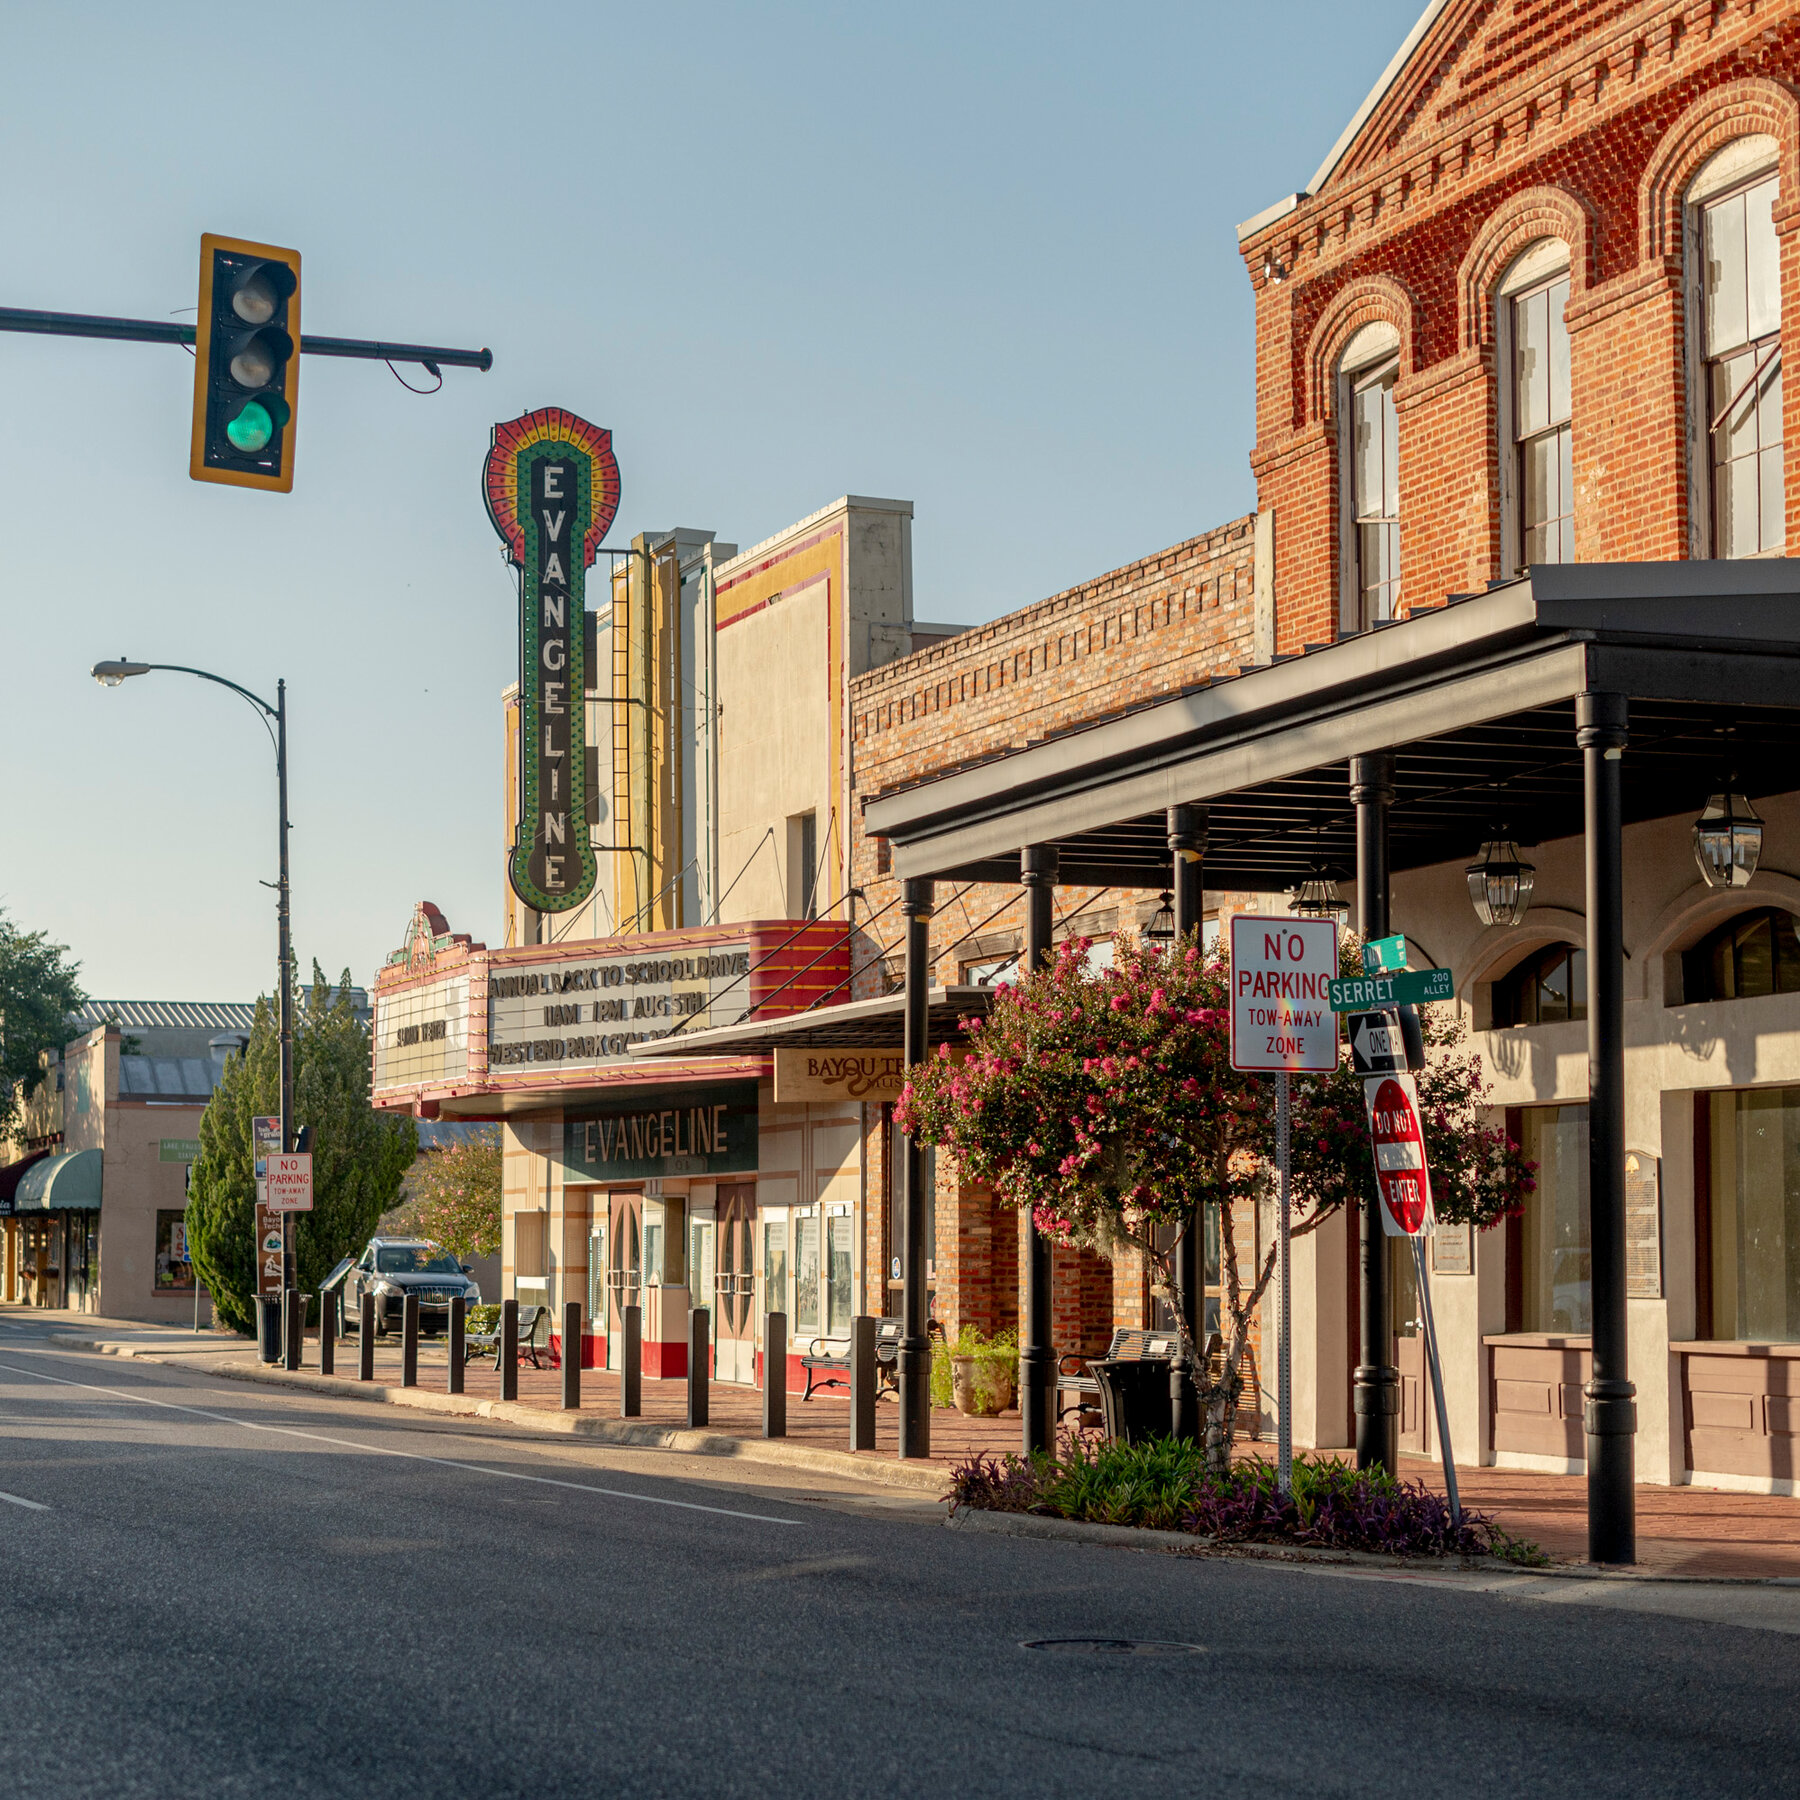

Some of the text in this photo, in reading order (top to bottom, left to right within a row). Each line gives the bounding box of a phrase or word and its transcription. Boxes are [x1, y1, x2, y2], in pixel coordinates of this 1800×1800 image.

[542, 466, 567, 888] EVANGELINE
[1264, 933, 1304, 962] NO
[488, 952, 750, 999] ANNUAL BACK TO SCHOOL DRIVE
[1239, 970, 1331, 1000] PARKING
[1432, 972, 1449, 983] 200
[1332, 979, 1394, 1005] SERRET
[1423, 984, 1450, 995] ALLEY
[633, 994, 666, 1019] AUG
[671, 991, 704, 1016] 5TH
[1248, 1008, 1322, 1027] TOW-AWAY
[488, 1041, 533, 1065] WEST
[533, 1038, 564, 1061] END
[566, 1034, 606, 1058] PARK
[1266, 1037, 1305, 1054] ZONE
[1369, 1030, 1388, 1054] ONE
[807, 1057, 876, 1077] BAYOU
[1376, 1108, 1413, 1134] DO NOT
[584, 1104, 728, 1164] EVANGELINE
[280, 1160, 298, 1171] NO
[269, 1173, 310, 1185] PARKING
[1389, 1179, 1421, 1202] ENTER
[274, 1187, 305, 1195] TOW-AWAY
[281, 1197, 298, 1205] ZONE
